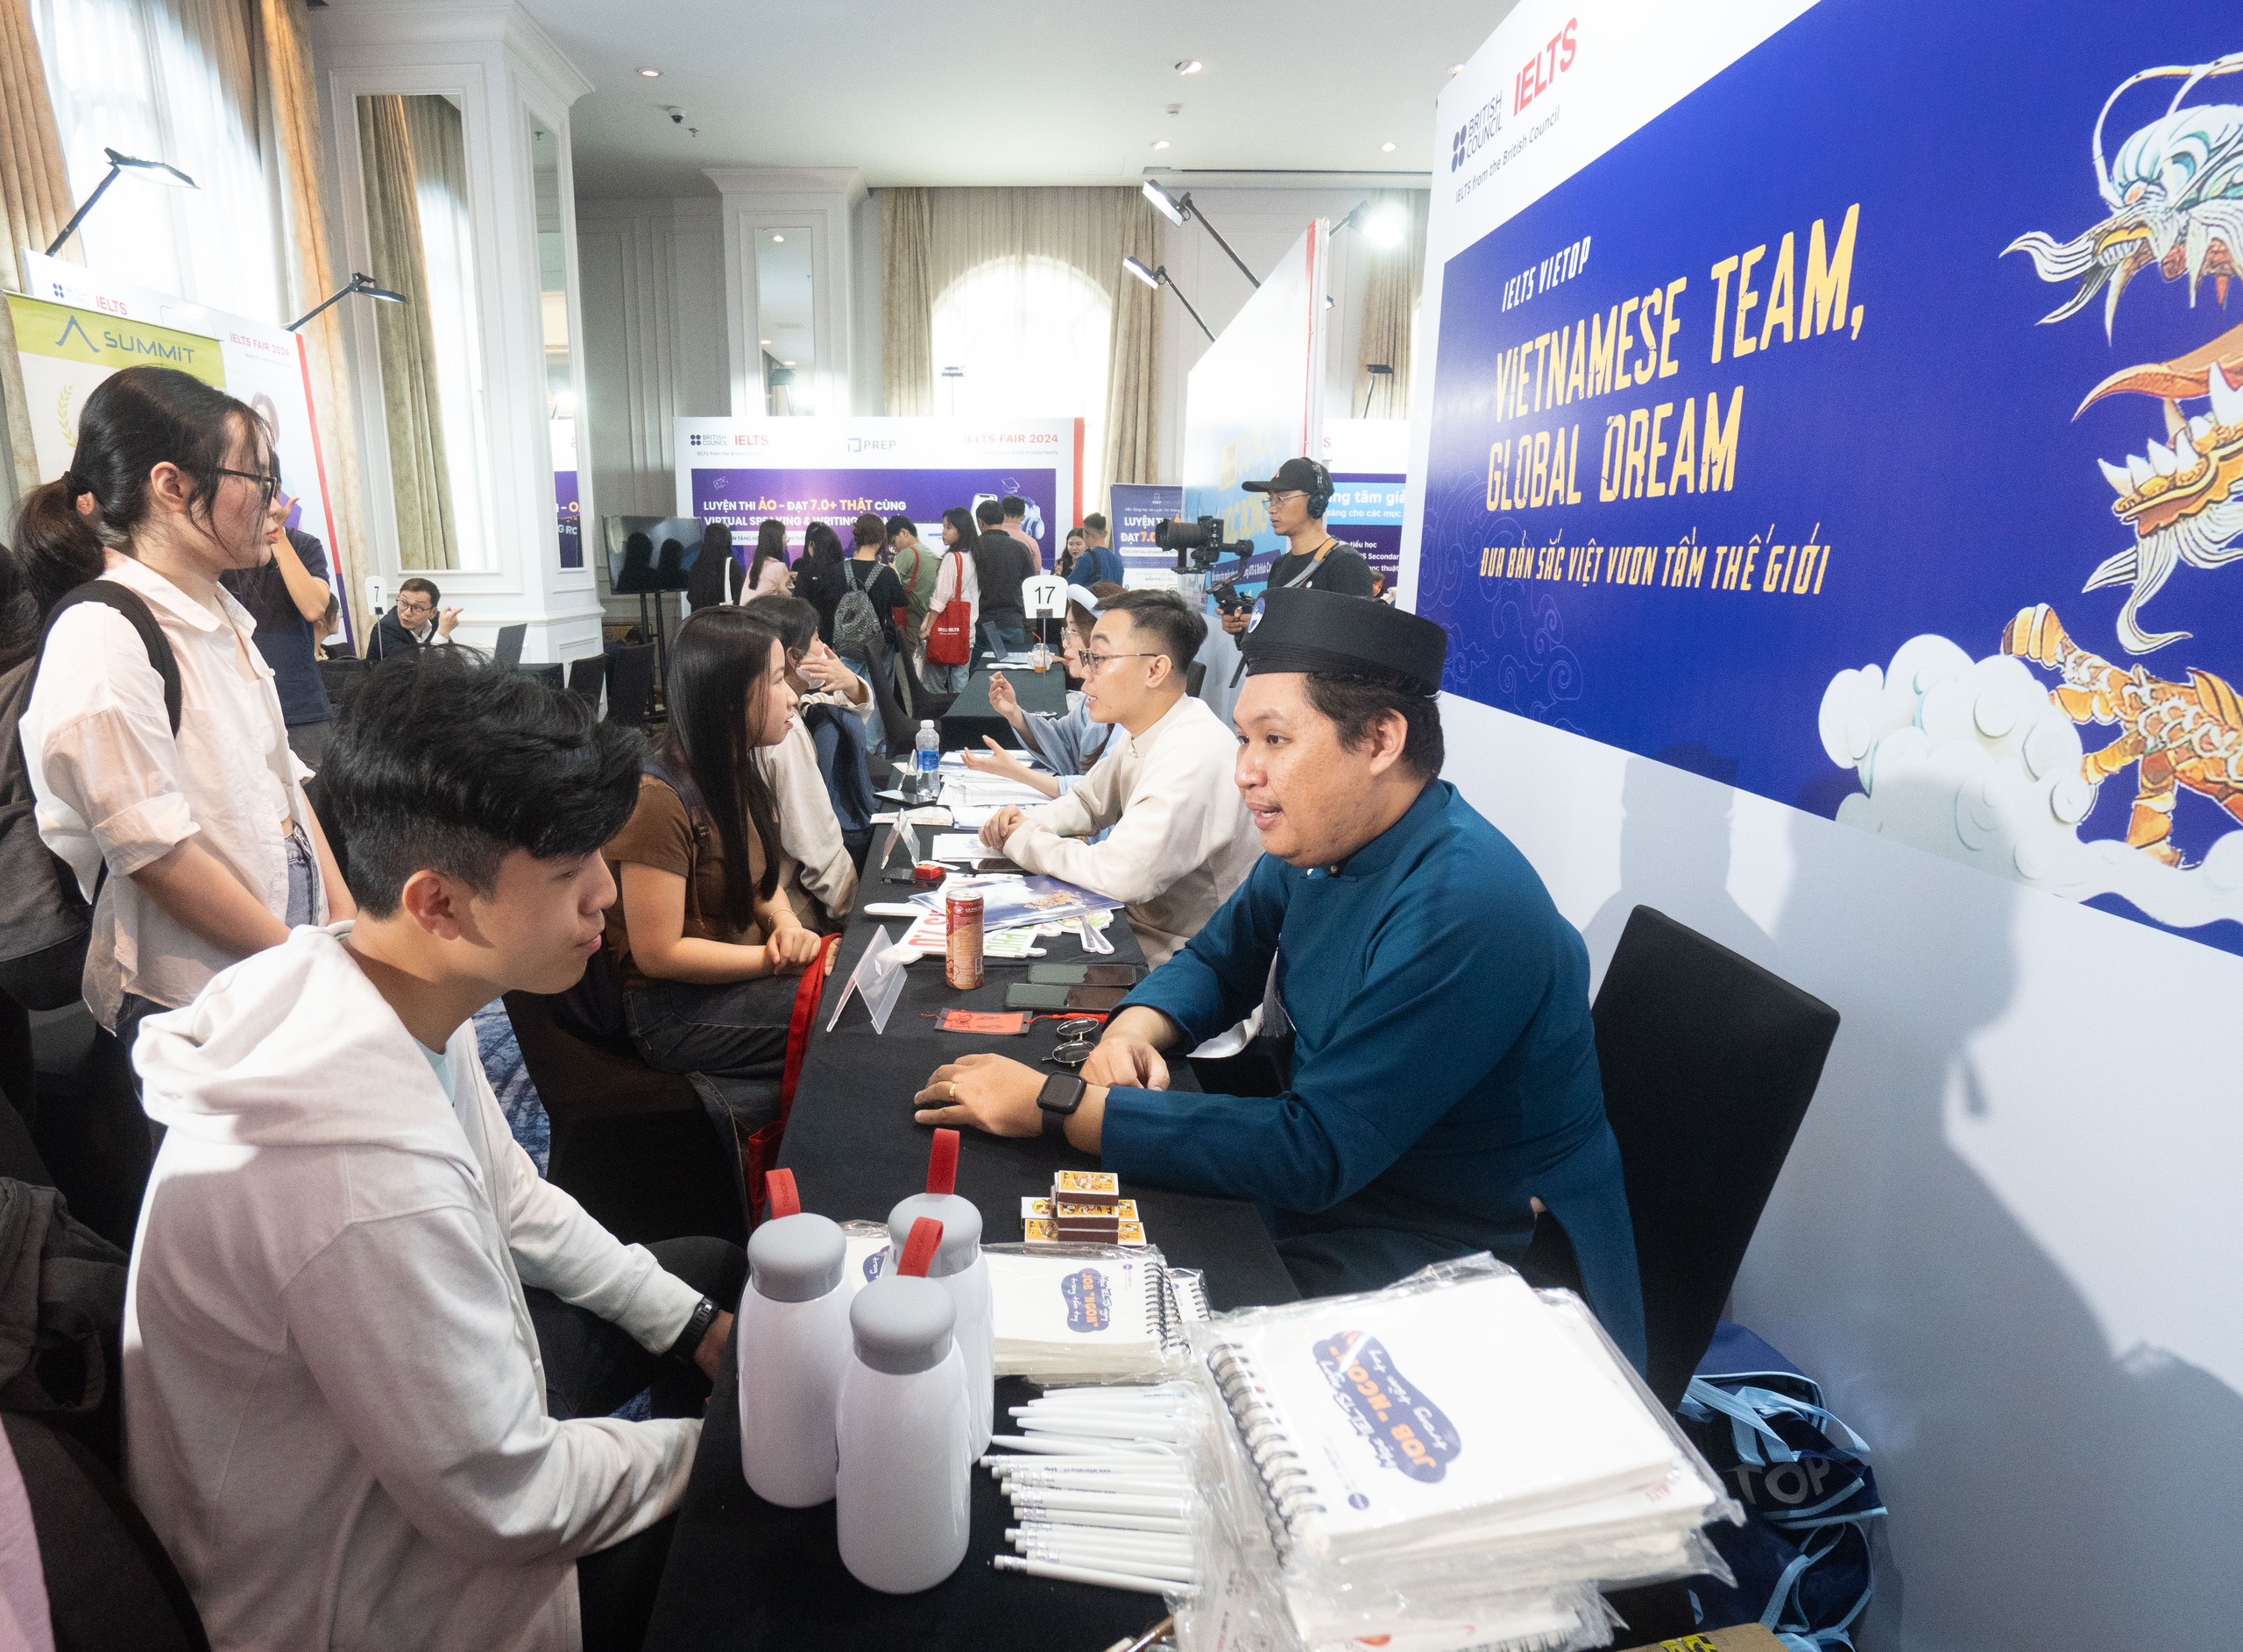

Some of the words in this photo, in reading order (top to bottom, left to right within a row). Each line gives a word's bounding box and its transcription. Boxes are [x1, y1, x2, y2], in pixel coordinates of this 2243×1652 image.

[1514, 17, 1578, 117] IELTS
[1468, 89, 1503, 138] BRITISH
[1467, 112, 1502, 159] COUNCIL
[1455, 180, 1471, 204] IELTS
[1472, 168, 1489, 191] from
[1489, 157, 1502, 177] the
[1503, 134, 1528, 166] British
[1529, 104, 1560, 144] Council
[1502, 265, 1535, 313] IELTS
[1539, 236, 1591, 295] VIETOP
[96, 296, 128, 315] IELTS
[1496, 276, 1688, 423] VIETNAMESE
[1710, 202, 1865, 365] TEAM,
[104, 330, 195, 364] SUMMIT
[230, 332, 251, 347] IELTS
[253, 339, 270, 351] FAIR
[272, 344, 290, 356] 2024
[735, 434, 769, 446] IELTS
[864, 440, 896, 449] PREP
[964, 434, 995, 443] IELTS
[1000, 434, 1026, 443] FAIR
[1030, 434, 1059, 443] 2024
[1486, 423, 1582, 512] GLOBAL
[1599, 385, 1744, 503] DREAM
[704, 499, 737, 513] LUYỆN
[739, 501, 756, 511] THI
[758, 496, 777, 511] ẢO
[787, 500, 809, 513] ĐẠT
[810, 498, 838, 511] 7.0+
[839, 497, 873, 514] THẬT
[874, 498, 906, 511] CÙNG
[1355, 491, 1381, 504] tâm
[704, 516, 748, 526] VIRTUAL
[1124, 514, 1155, 529] LUYỆN
[1366, 508, 1381, 517] các
[1383, 510, 1402, 519] mục
[1121, 533, 1140, 545] ĐẠT
[1535, 528, 1565, 581] SẮC
[1567, 538, 1604, 588] VIỆT
[1661, 526, 1708, 589] TẦM
[1711, 523, 1775, 591] THẾ
[1762, 522, 1831, 595] GIỚI
[374, 586, 379, 602] 7
[1035, 586, 1056, 604] 17
[1067, 1277, 1079, 1295] trong
[1082, 1272, 1094, 1291] JOB
[1101, 1288, 1113, 1307] IELTS
[1070, 1310, 1082, 1323] tay
[1368, 1349, 1387, 1373] tay
[1332, 1391, 1376, 1437] IELTS
[1412, 1406, 1447, 1451] trong
[1390, 1423, 1437, 1469] JOB
